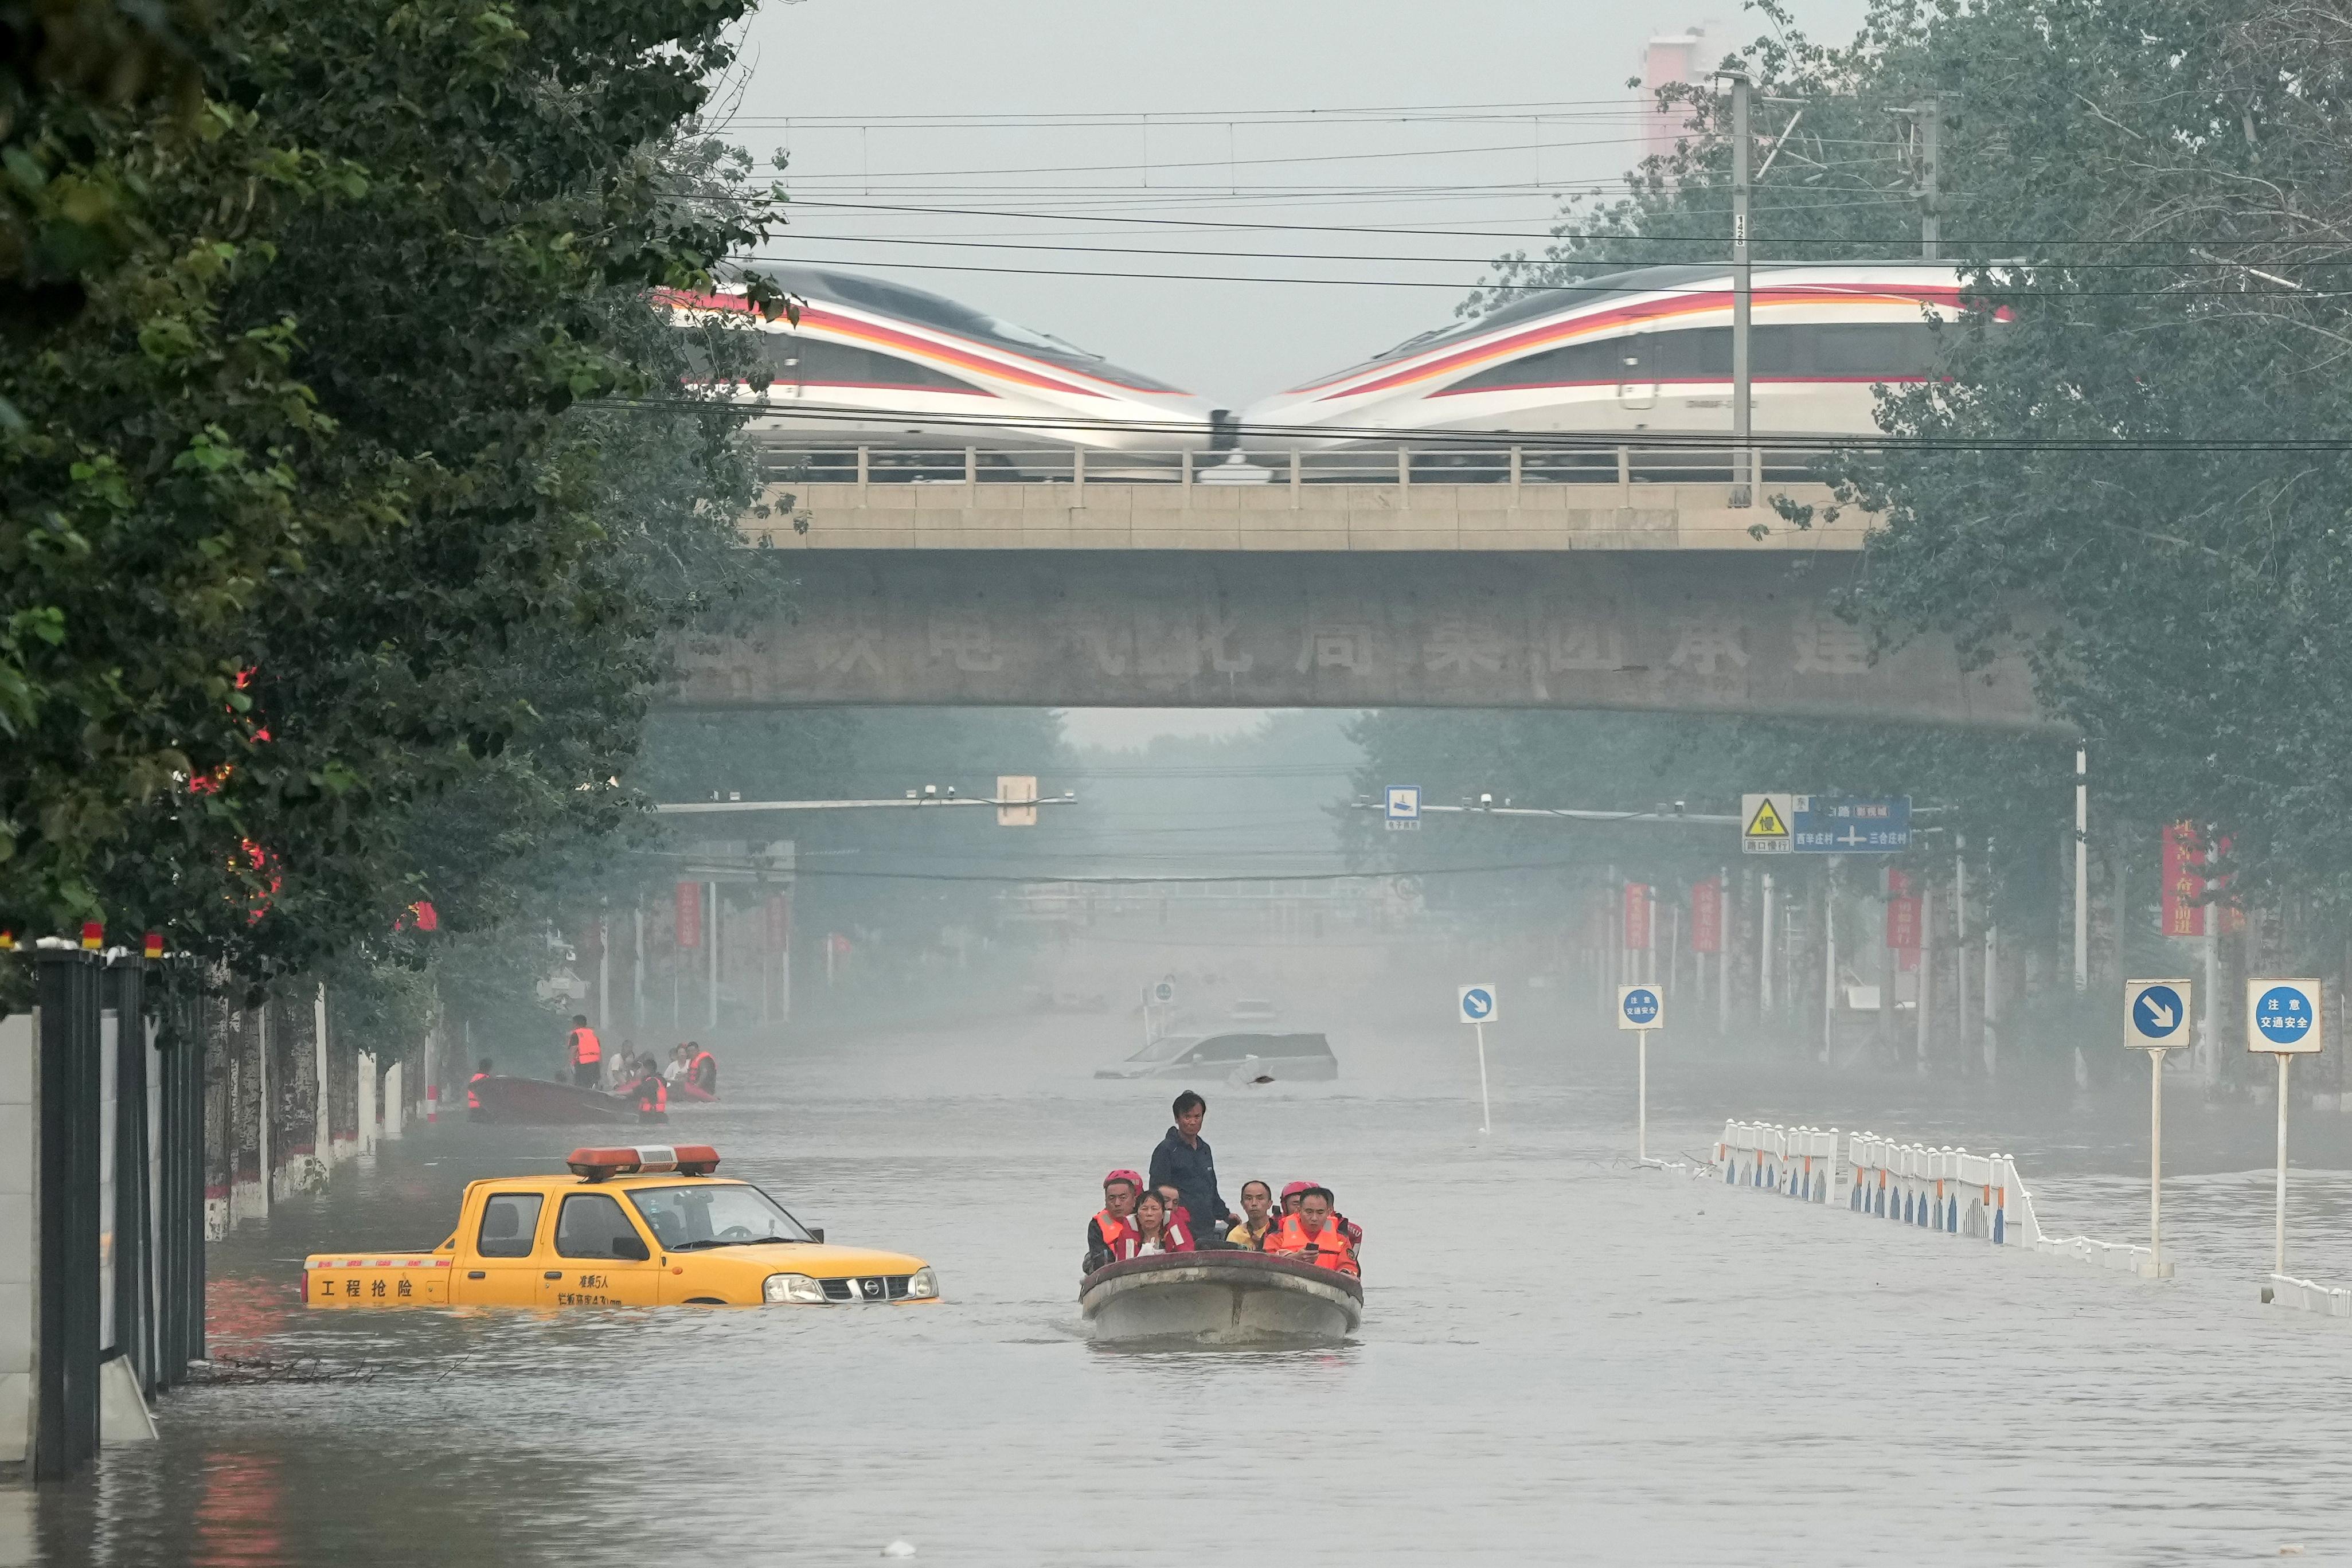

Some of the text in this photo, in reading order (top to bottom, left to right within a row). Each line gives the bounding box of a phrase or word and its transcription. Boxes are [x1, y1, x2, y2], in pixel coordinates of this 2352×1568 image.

[1759, 816, 1775, 832] 慢
[1747, 840, 1788, 851] 路口慢行
[1631, 996, 1651, 1004] 注意
[2268, 999, 2302, 1011] 注意
[1626, 1007, 1656, 1015] 交通安全
[2260, 1016, 2308, 1030] 交通安全
[321, 1279, 413, 1297] 工程抢险
